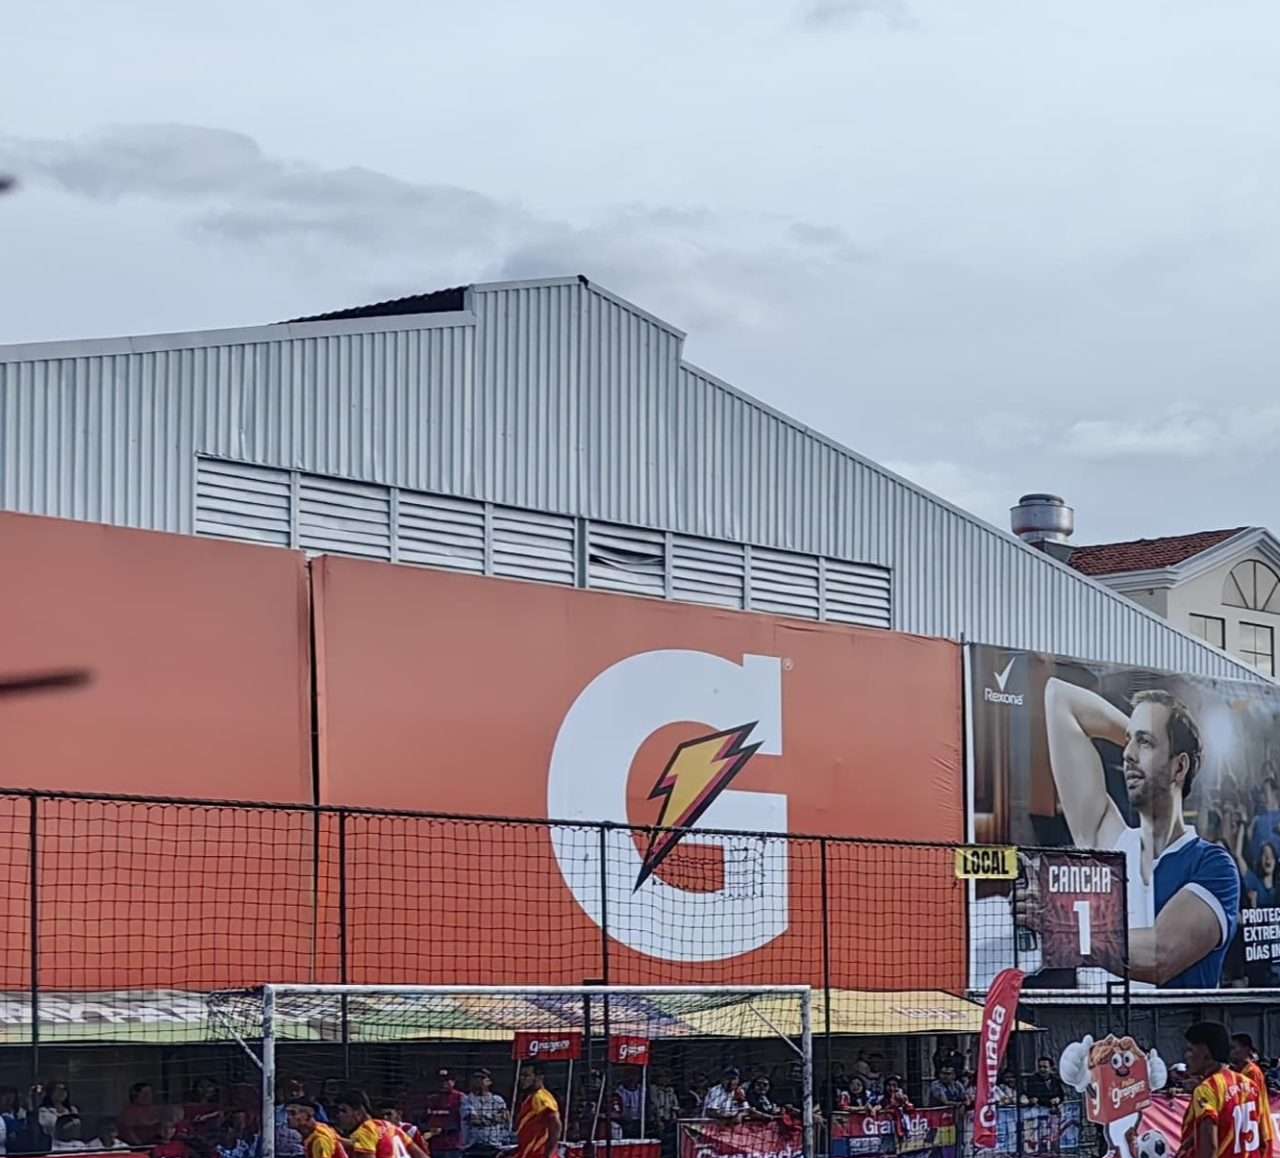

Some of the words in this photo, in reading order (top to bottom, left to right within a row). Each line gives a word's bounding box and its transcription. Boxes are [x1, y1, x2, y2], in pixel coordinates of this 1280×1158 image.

[984, 688, 1024, 705] Rexona
[547, 649, 789, 962] G
[963, 850, 1009, 875] LOCAL
[1049, 865, 1111, 893] CANCHA
[1073, 900, 1092, 955] 1
[1246, 942, 1270, 961] DÍAS
[863, 1114, 928, 1135] Grada
[1232, 1101, 1260, 1155] 15
